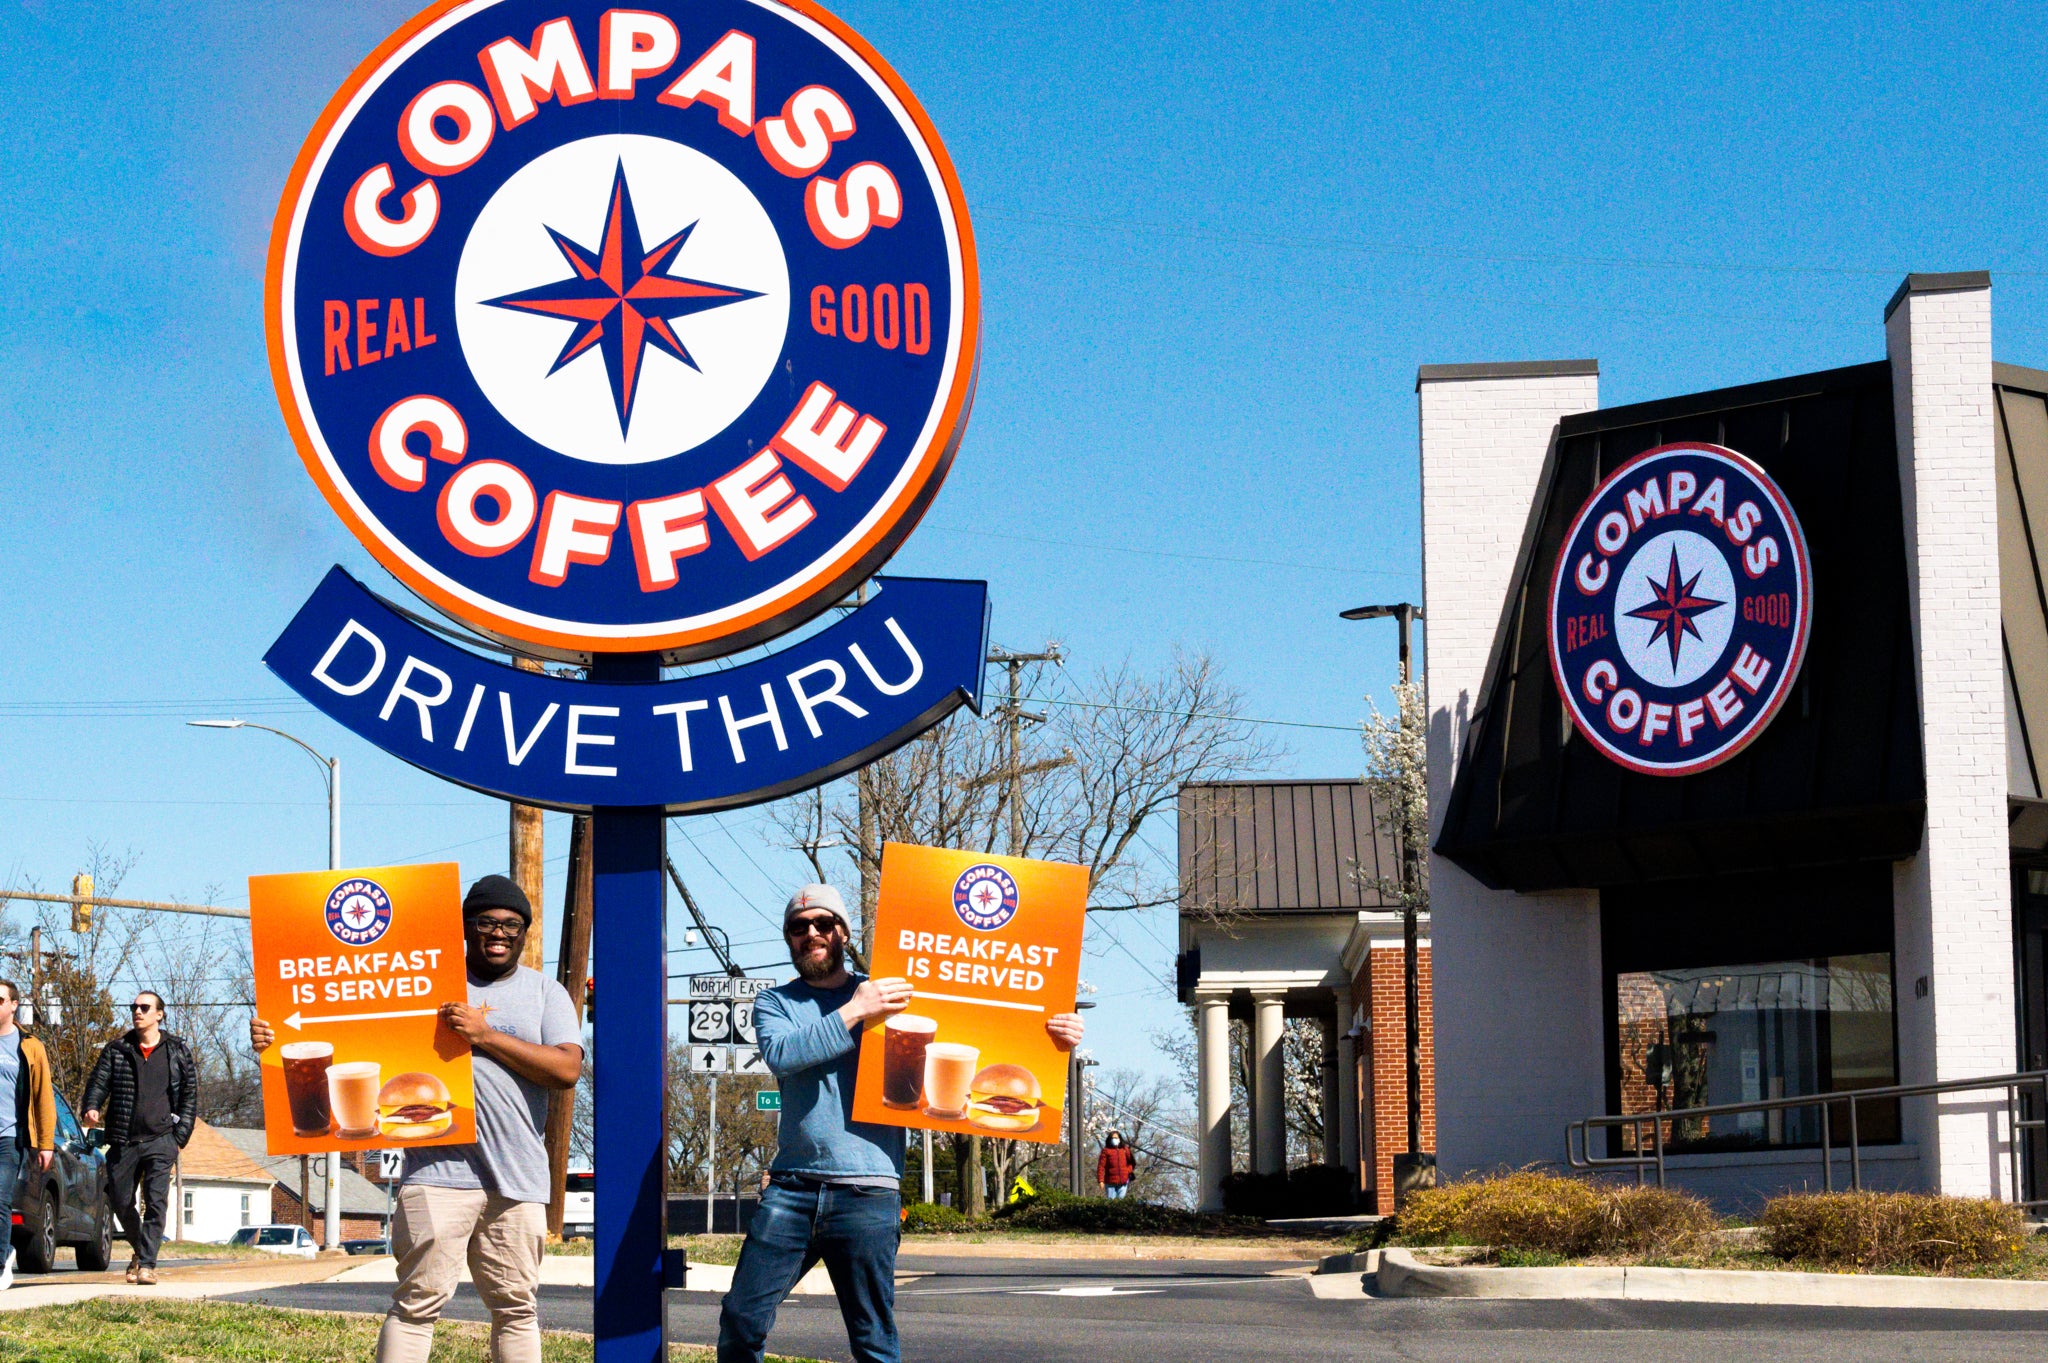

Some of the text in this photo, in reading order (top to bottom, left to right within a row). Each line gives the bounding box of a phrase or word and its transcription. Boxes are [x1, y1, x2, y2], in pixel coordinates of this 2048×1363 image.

[344, 9, 902, 257] COMPASS
[324, 282, 932, 377] REAL GOOD
[369, 381, 887, 592] COFFEE
[1576, 470, 1780, 596] COMPASS
[1567, 592, 1790, 653] REAL GOOD
[311, 617, 924, 777] DRIVE THRU
[1582, 643, 1772, 747] COFFEE
[330, 882, 386, 909] COMPASS
[959, 868, 1015, 896] COMPASS
[333, 920, 386, 942] COFFEE
[959, 903, 1010, 928] COFFEE
[898, 929, 1059, 967] BREAKFAST
[279, 949, 442, 980] BREAKFAST
[906, 957, 1044, 991] IS SERVED
[292, 976, 432, 1004] IS SERVED
[692, 980, 730, 993] NORTH
[696, 1011, 724, 1030] 29
[760, 1096, 771, 1105] To
